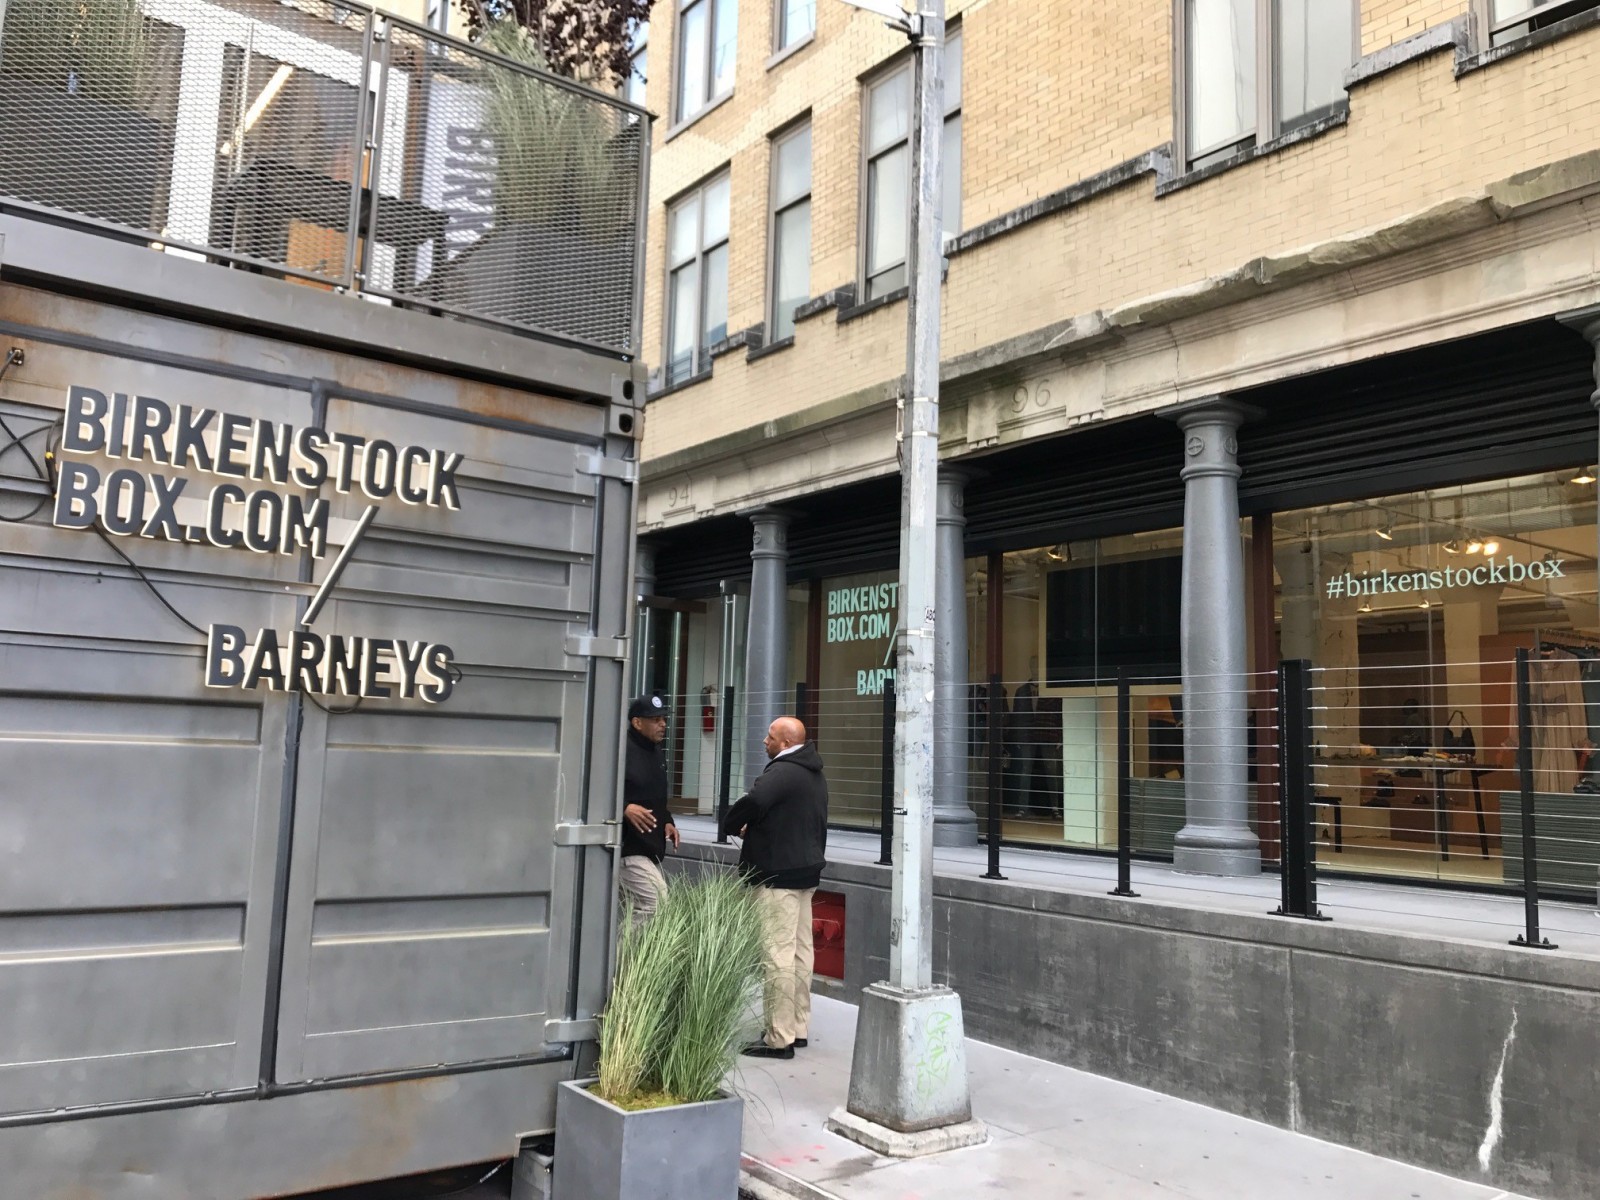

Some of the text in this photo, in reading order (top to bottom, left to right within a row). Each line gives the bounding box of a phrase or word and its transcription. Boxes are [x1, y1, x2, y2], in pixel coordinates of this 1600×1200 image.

[1012, 379, 1051, 413] 96
[62, 385, 465, 511] BIRKENSTOCK
[53, 461, 330, 559] BOX.COM
[668, 484, 690, 508] 94
[1326, 555, 1566, 599] #birkenstockbox
[827, 612, 890, 643] BOX.COM
[205, 623, 456, 704] BARNEYS
